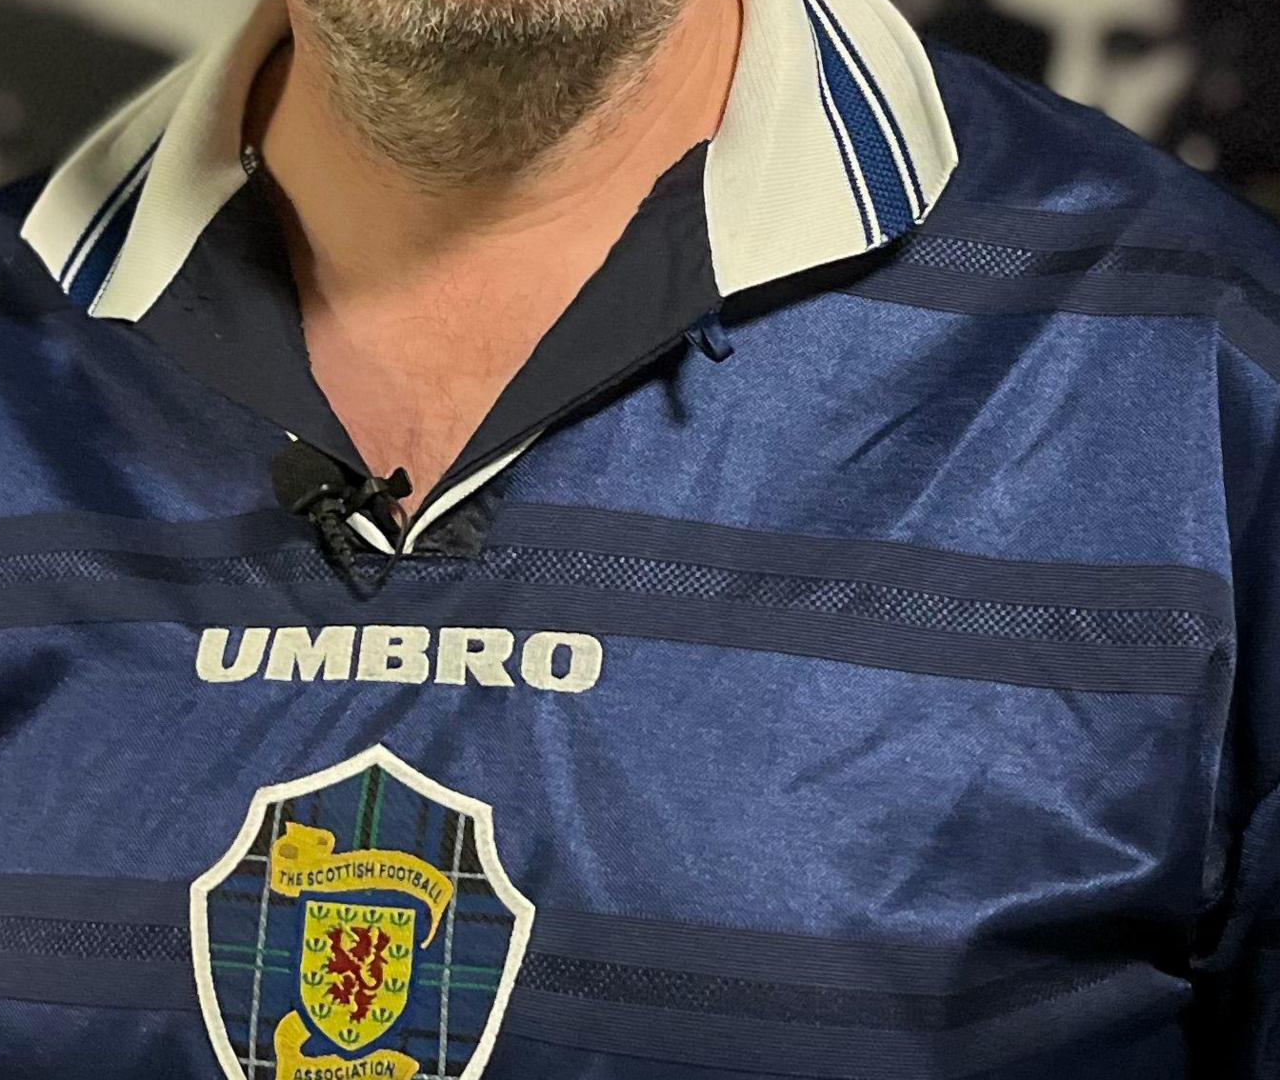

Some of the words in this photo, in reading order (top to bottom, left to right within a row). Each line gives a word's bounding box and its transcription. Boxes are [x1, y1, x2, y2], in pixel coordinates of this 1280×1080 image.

[196, 625, 603, 693] UMBRO
[280, 870, 303, 886] THE
[307, 863, 374, 886] SCOTTISH
[379, 864, 443, 904] FOOTBALL
[294, 1060, 395, 1080] ASSOCIATION
